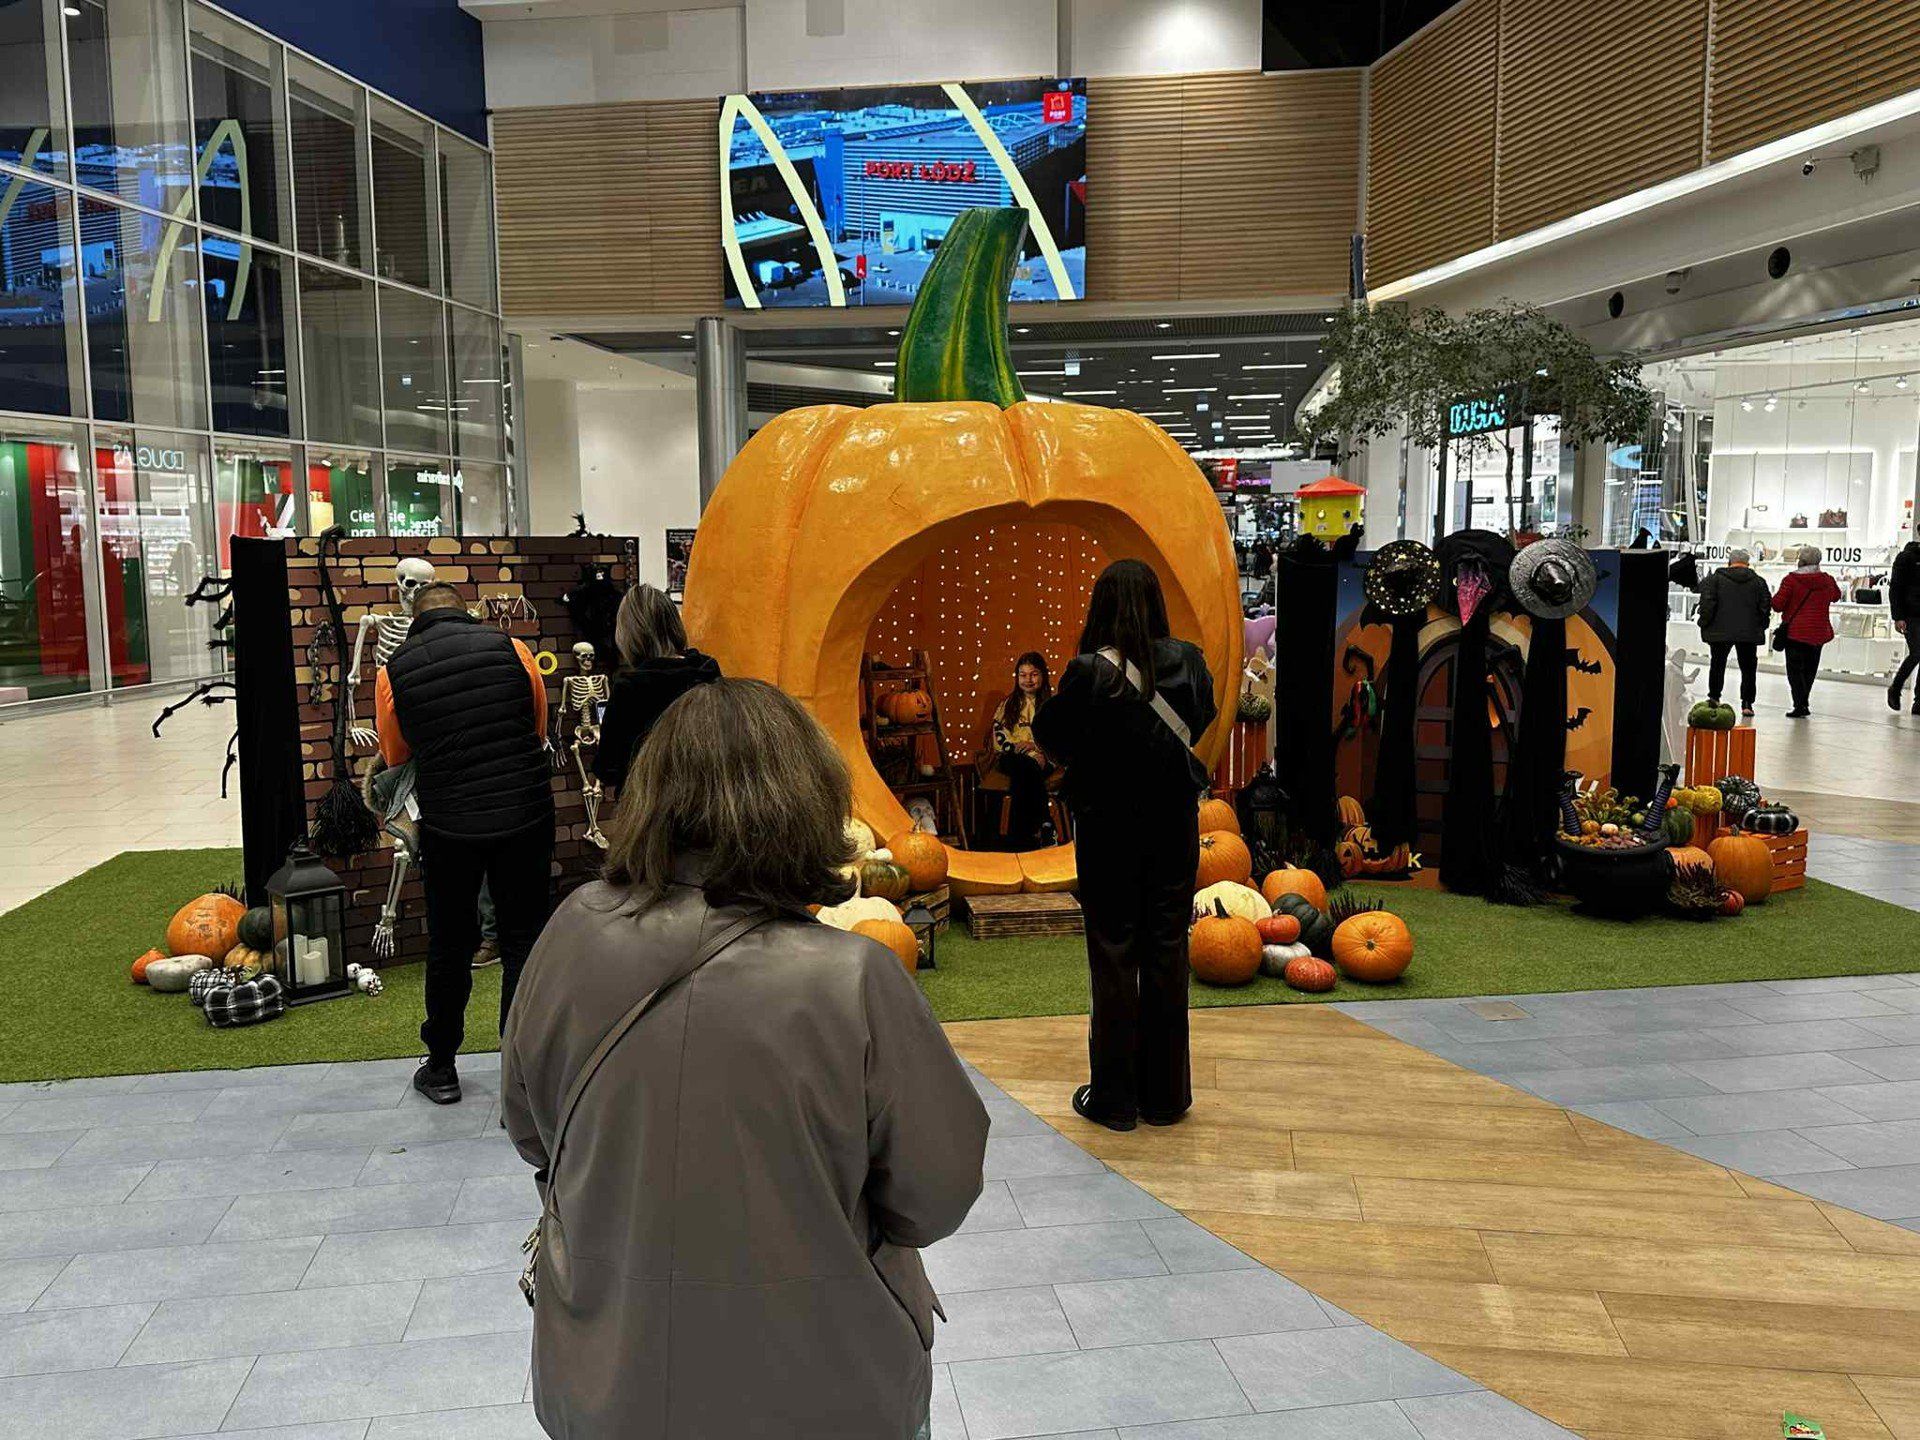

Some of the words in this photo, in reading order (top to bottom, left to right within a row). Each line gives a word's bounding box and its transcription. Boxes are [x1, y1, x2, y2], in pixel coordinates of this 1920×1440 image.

[865, 160, 914, 180] PORT
[350, 509, 375, 522] Cies
[1706, 546, 1732, 559] TOUS
[1826, 547, 1862, 562] TOUS
